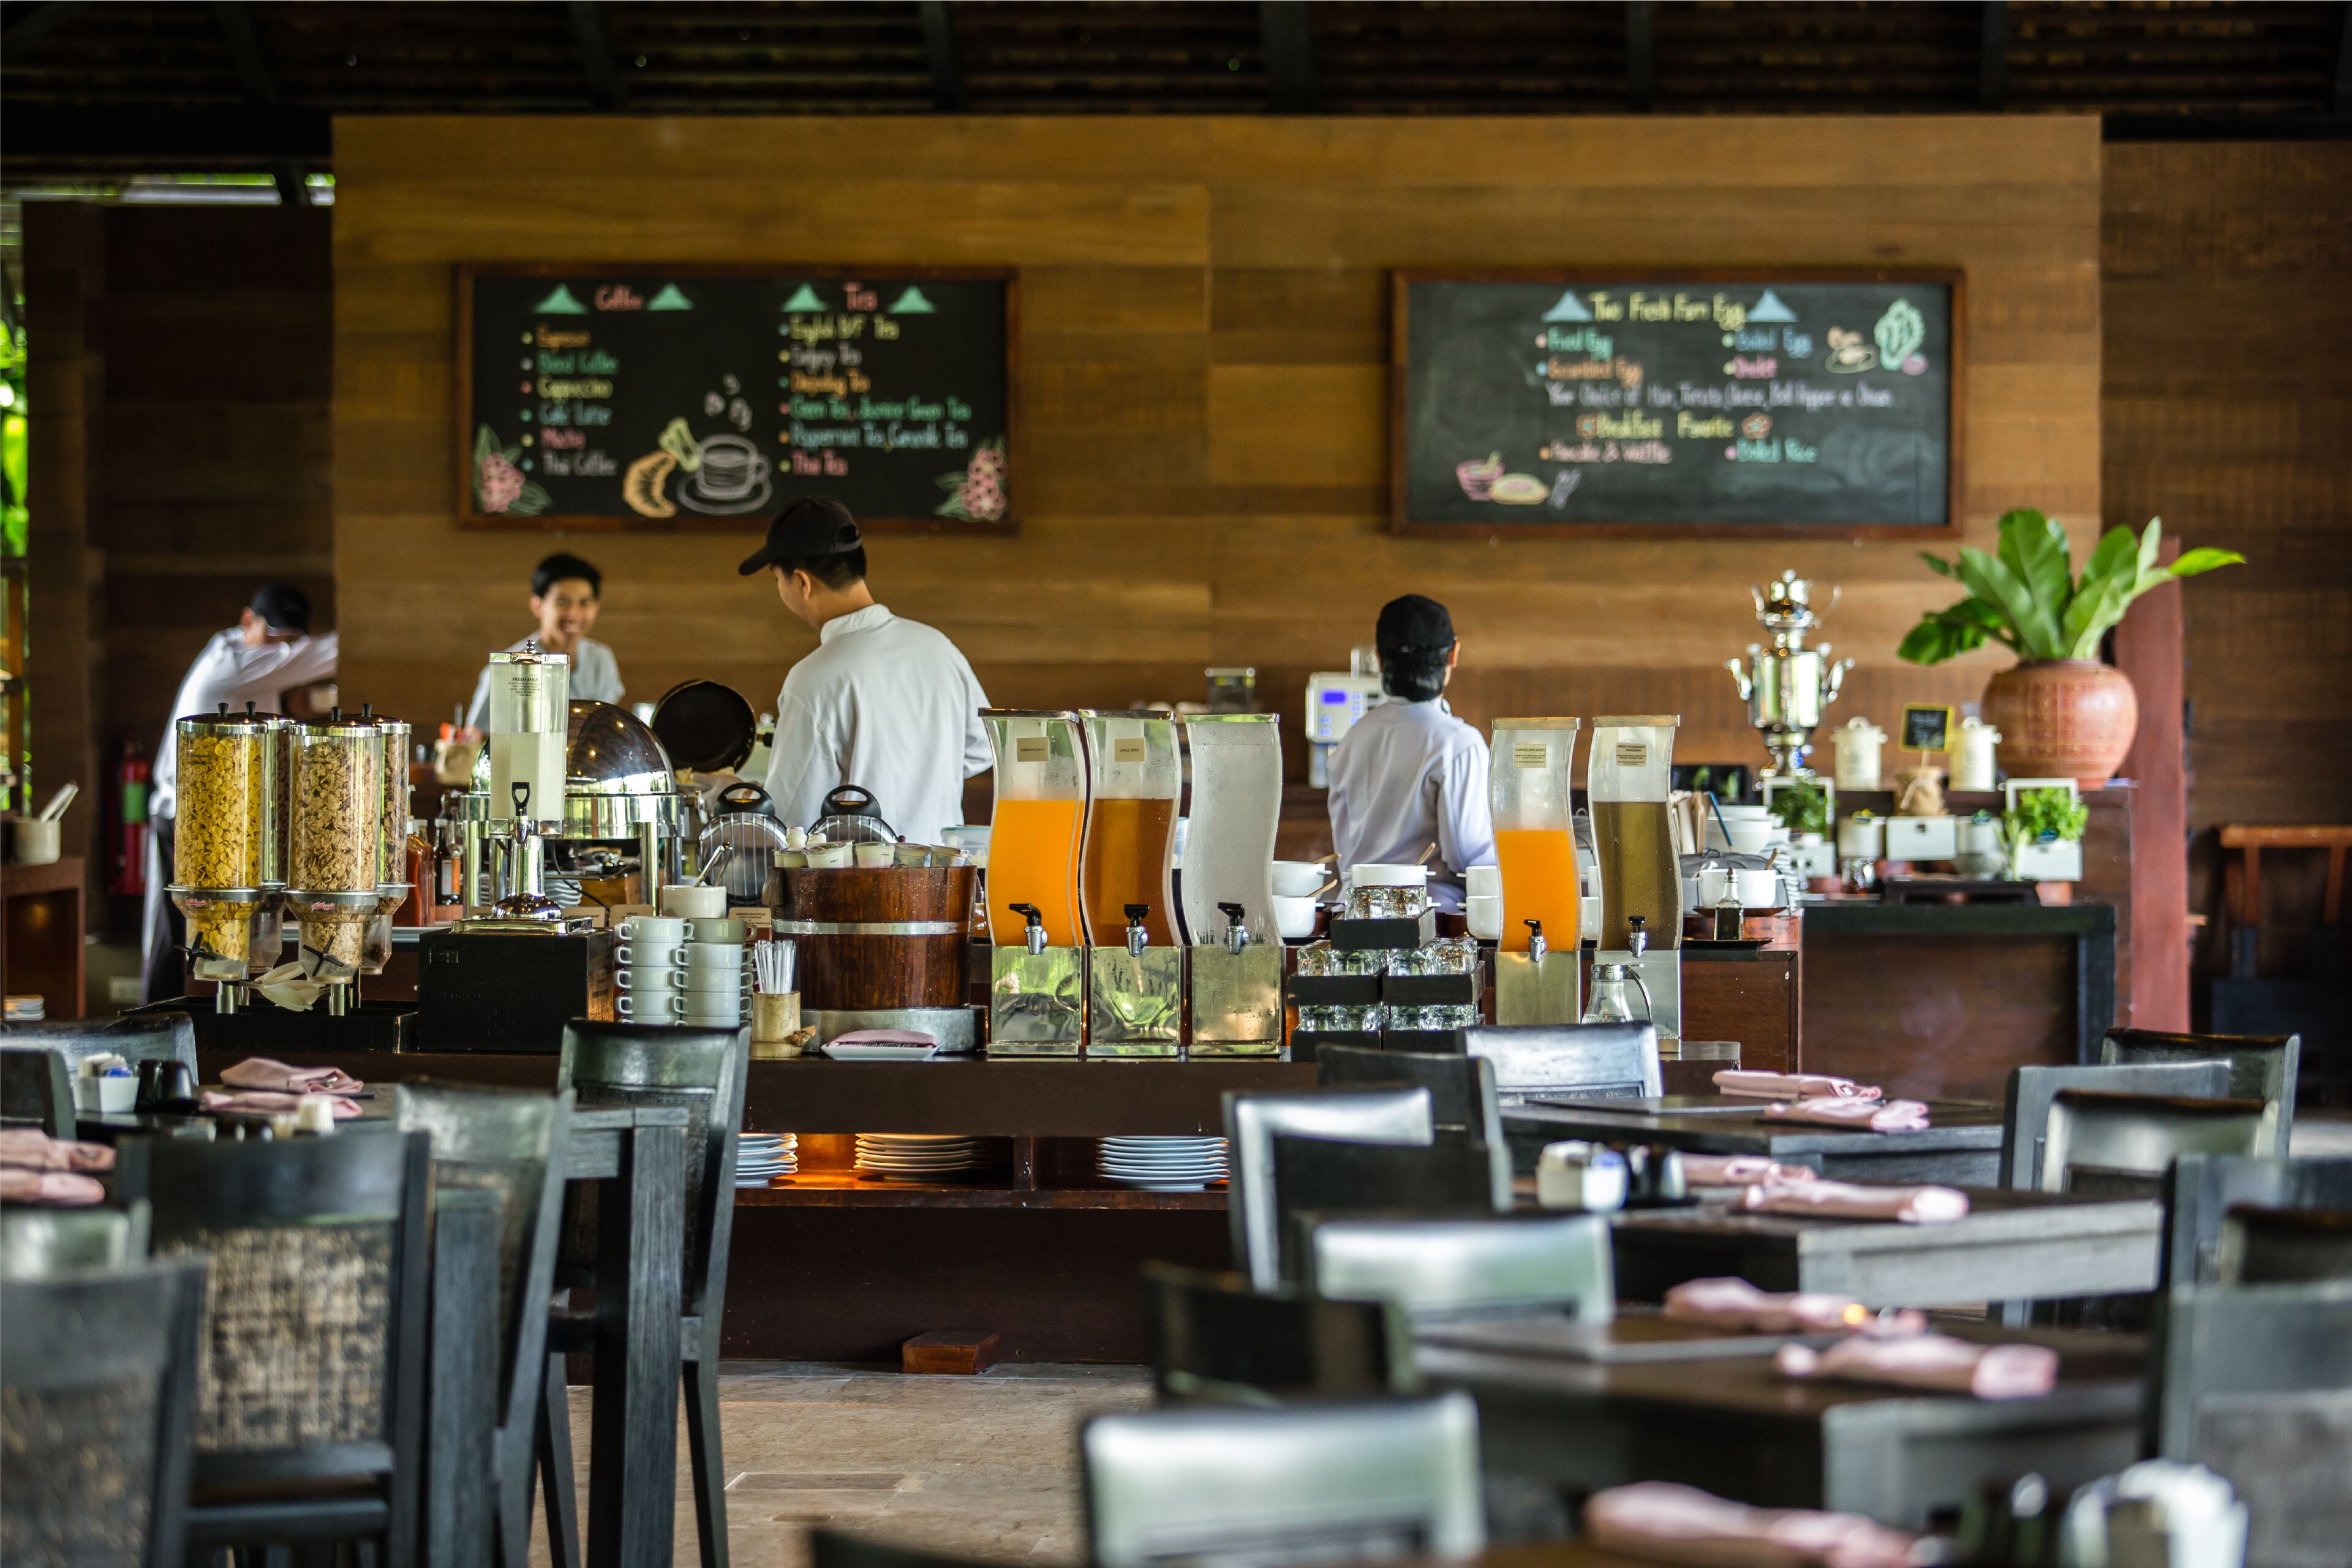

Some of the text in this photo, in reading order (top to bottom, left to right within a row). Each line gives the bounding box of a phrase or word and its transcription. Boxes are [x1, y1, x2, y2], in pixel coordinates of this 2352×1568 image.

[594, 284, 644, 311] Coffee
[843, 282, 878, 311] Tea
[1588, 291, 1623, 322] Two
[1629, 292, 1672, 322] Fresh
[1674, 292, 1711, 322] Farm
[790, 314, 836, 347] English
[873, 314, 900, 340] Tea
[1548, 326, 1614, 361] Fried Egg
[1735, 325, 1813, 359] Boiled Egg
[578, 349, 619, 375] Coffee
[839, 341, 862, 367] Tea
[845, 369, 871, 393] Tea
[1548, 356, 1615, 380] Scrambled
[790, 395, 826, 420] Green
[856, 395, 906, 420] Jasmine
[906, 396, 944, 421] Green
[946, 396, 972, 421] Tea
[1578, 381, 1623, 407] Choice
[1795, 379, 1836, 413] Pepper
[790, 421, 860, 452] Peppermint
[944, 421, 968, 448] Tea
[1597, 409, 1735, 439] Breakfast Favorite
[573, 448, 618, 476] Coffee
[823, 448, 848, 477] Tea
[1551, 439, 1601, 463] Pancake
[1603, 440, 1621, 463] &
[1738, 436, 1819, 462] Boiled Rice
[186, 898, 206, 907] Kellogg's
[312, 902, 336, 911] Kellogg's
